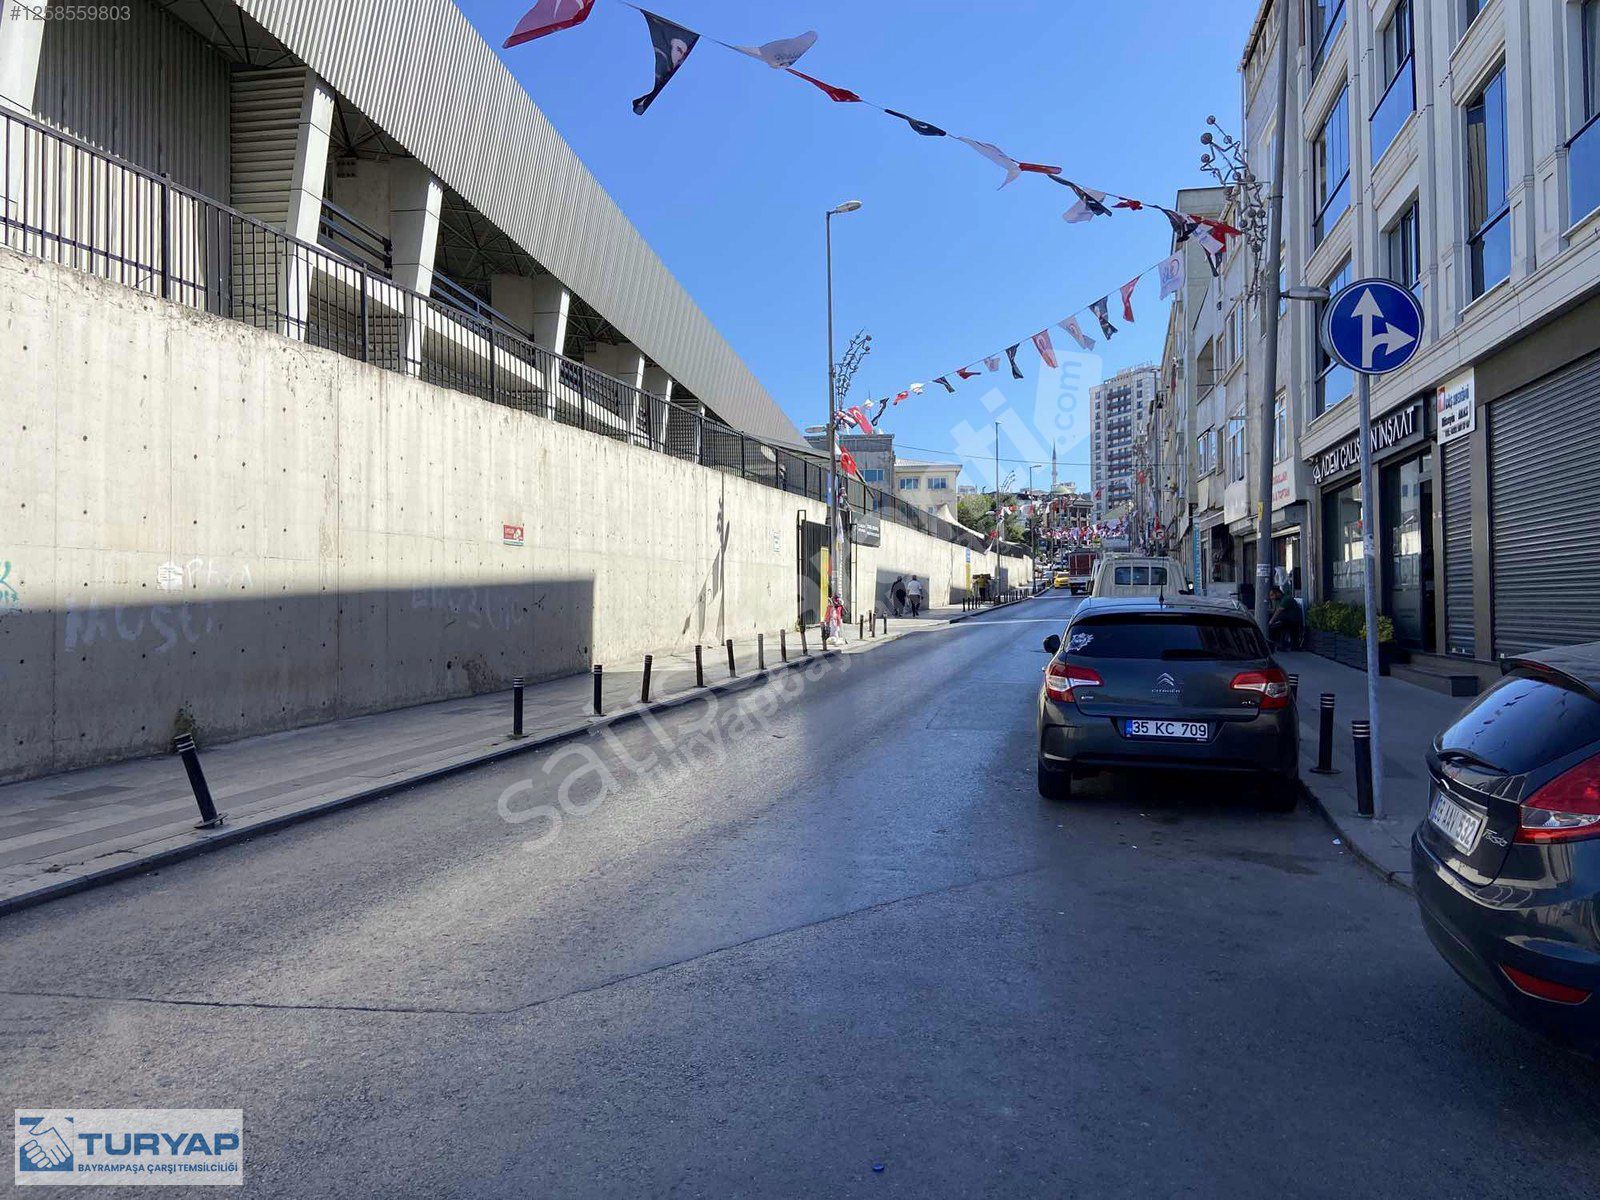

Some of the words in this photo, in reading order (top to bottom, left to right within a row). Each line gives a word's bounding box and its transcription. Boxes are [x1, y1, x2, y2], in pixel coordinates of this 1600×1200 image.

[1321, 449, 1340, 478] ADEM
[1340, 427, 1377, 470] ÇALIŞN
[1379, 405, 1414, 449] İNŞAAT
[1133, 721, 1149, 734] 35
[1155, 722, 1175, 735] KC
[1181, 723, 1207, 737] 709
